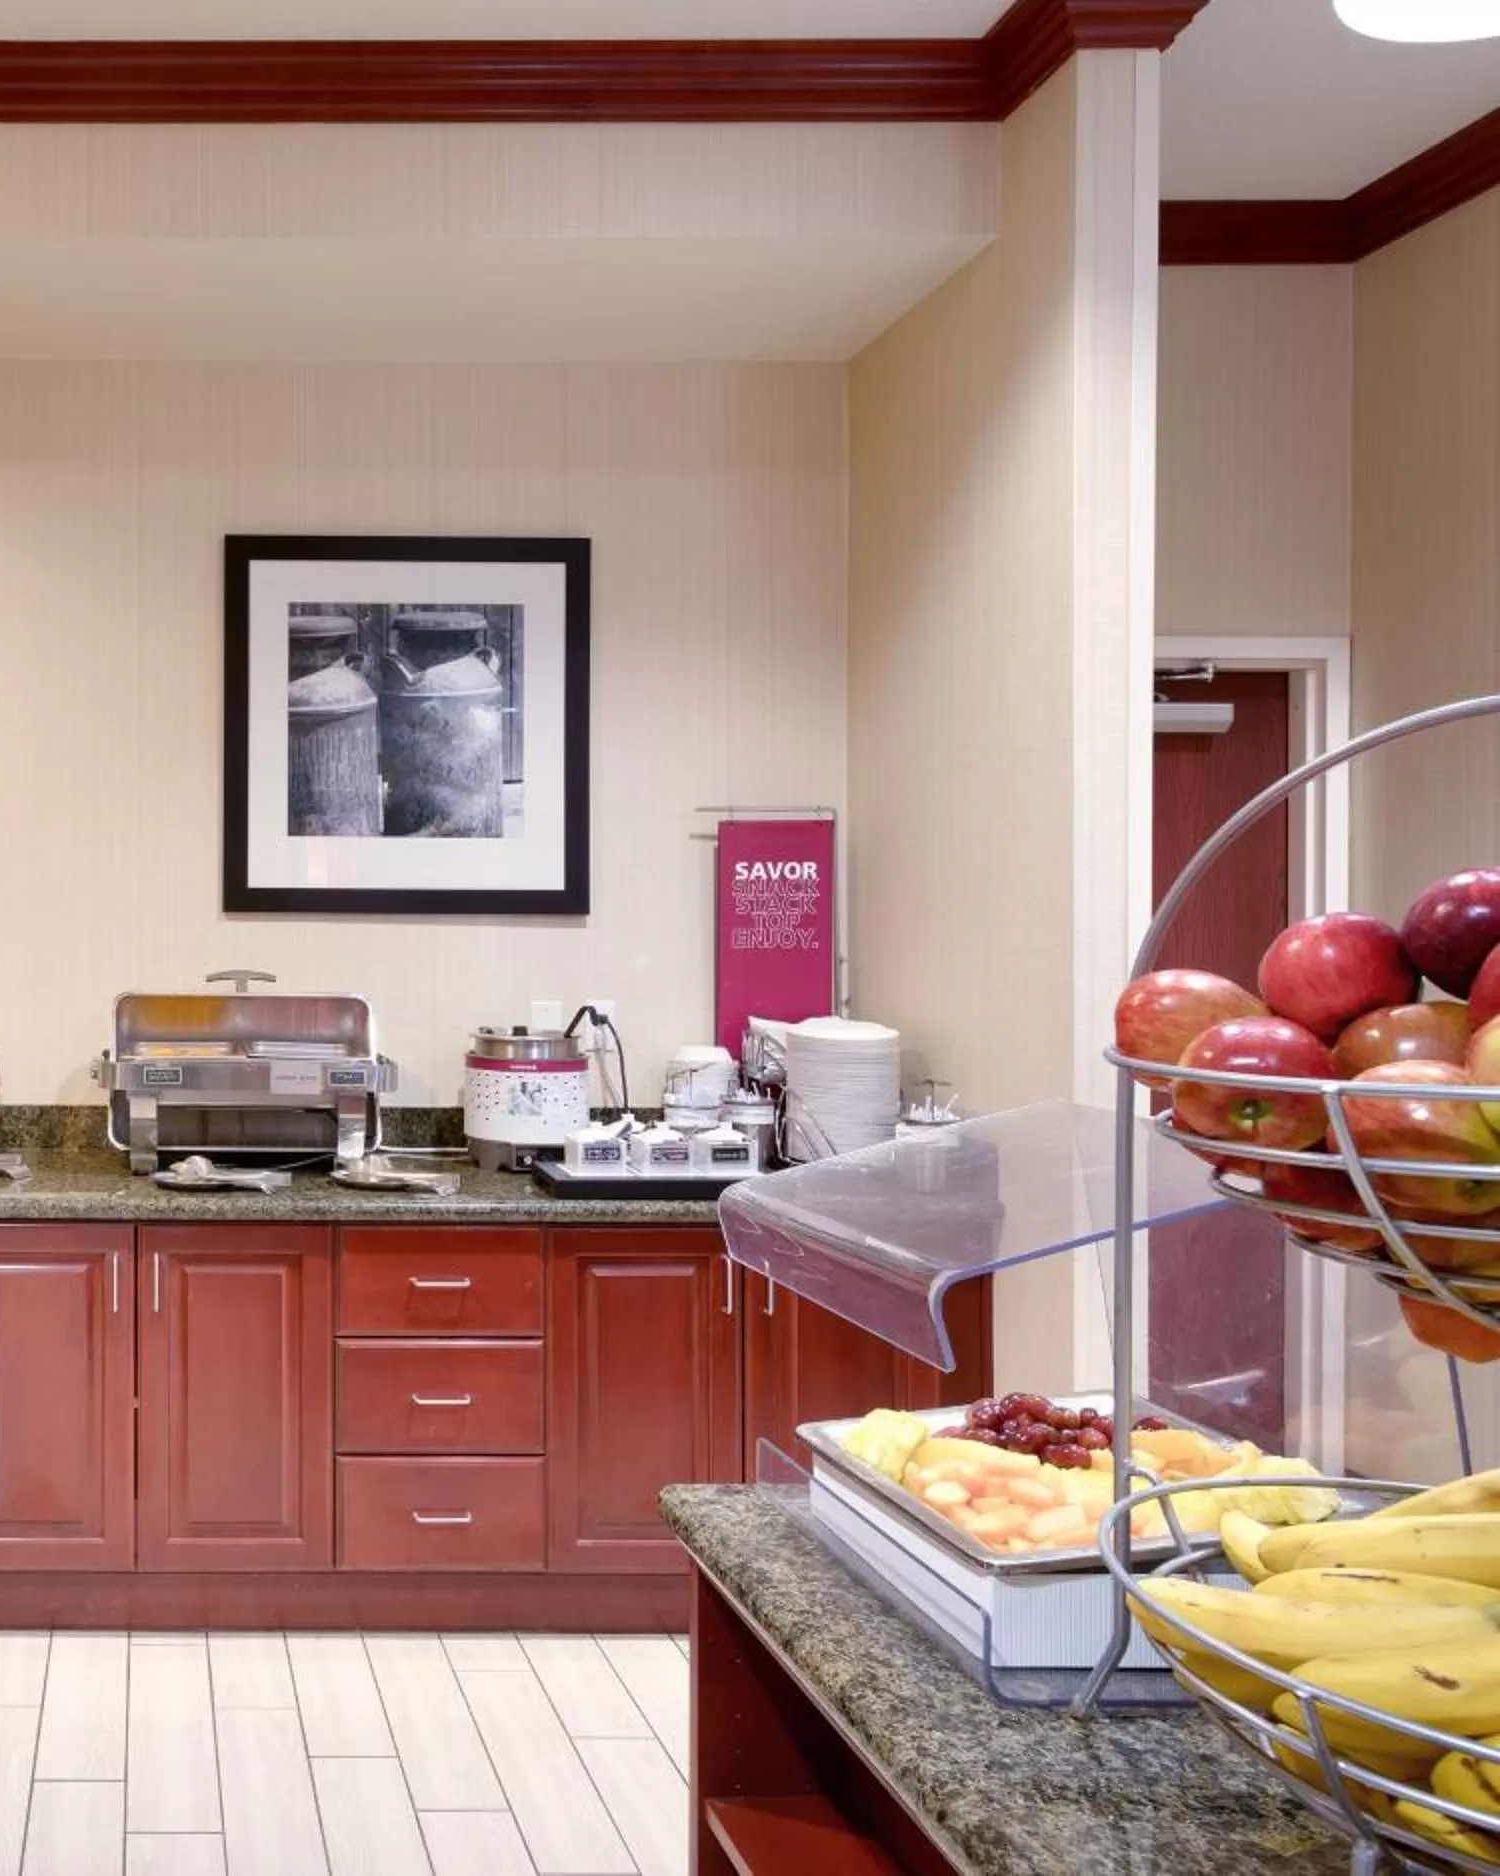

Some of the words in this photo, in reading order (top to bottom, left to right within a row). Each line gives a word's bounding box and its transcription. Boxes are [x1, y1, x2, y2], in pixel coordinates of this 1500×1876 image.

[734, 860, 818, 880] SAVOR
[731, 878, 820, 897] SNACK
[735, 894, 817, 915] STACK
[751, 911, 801, 931] TOP
[731, 928, 820, 949] ENJOY.
